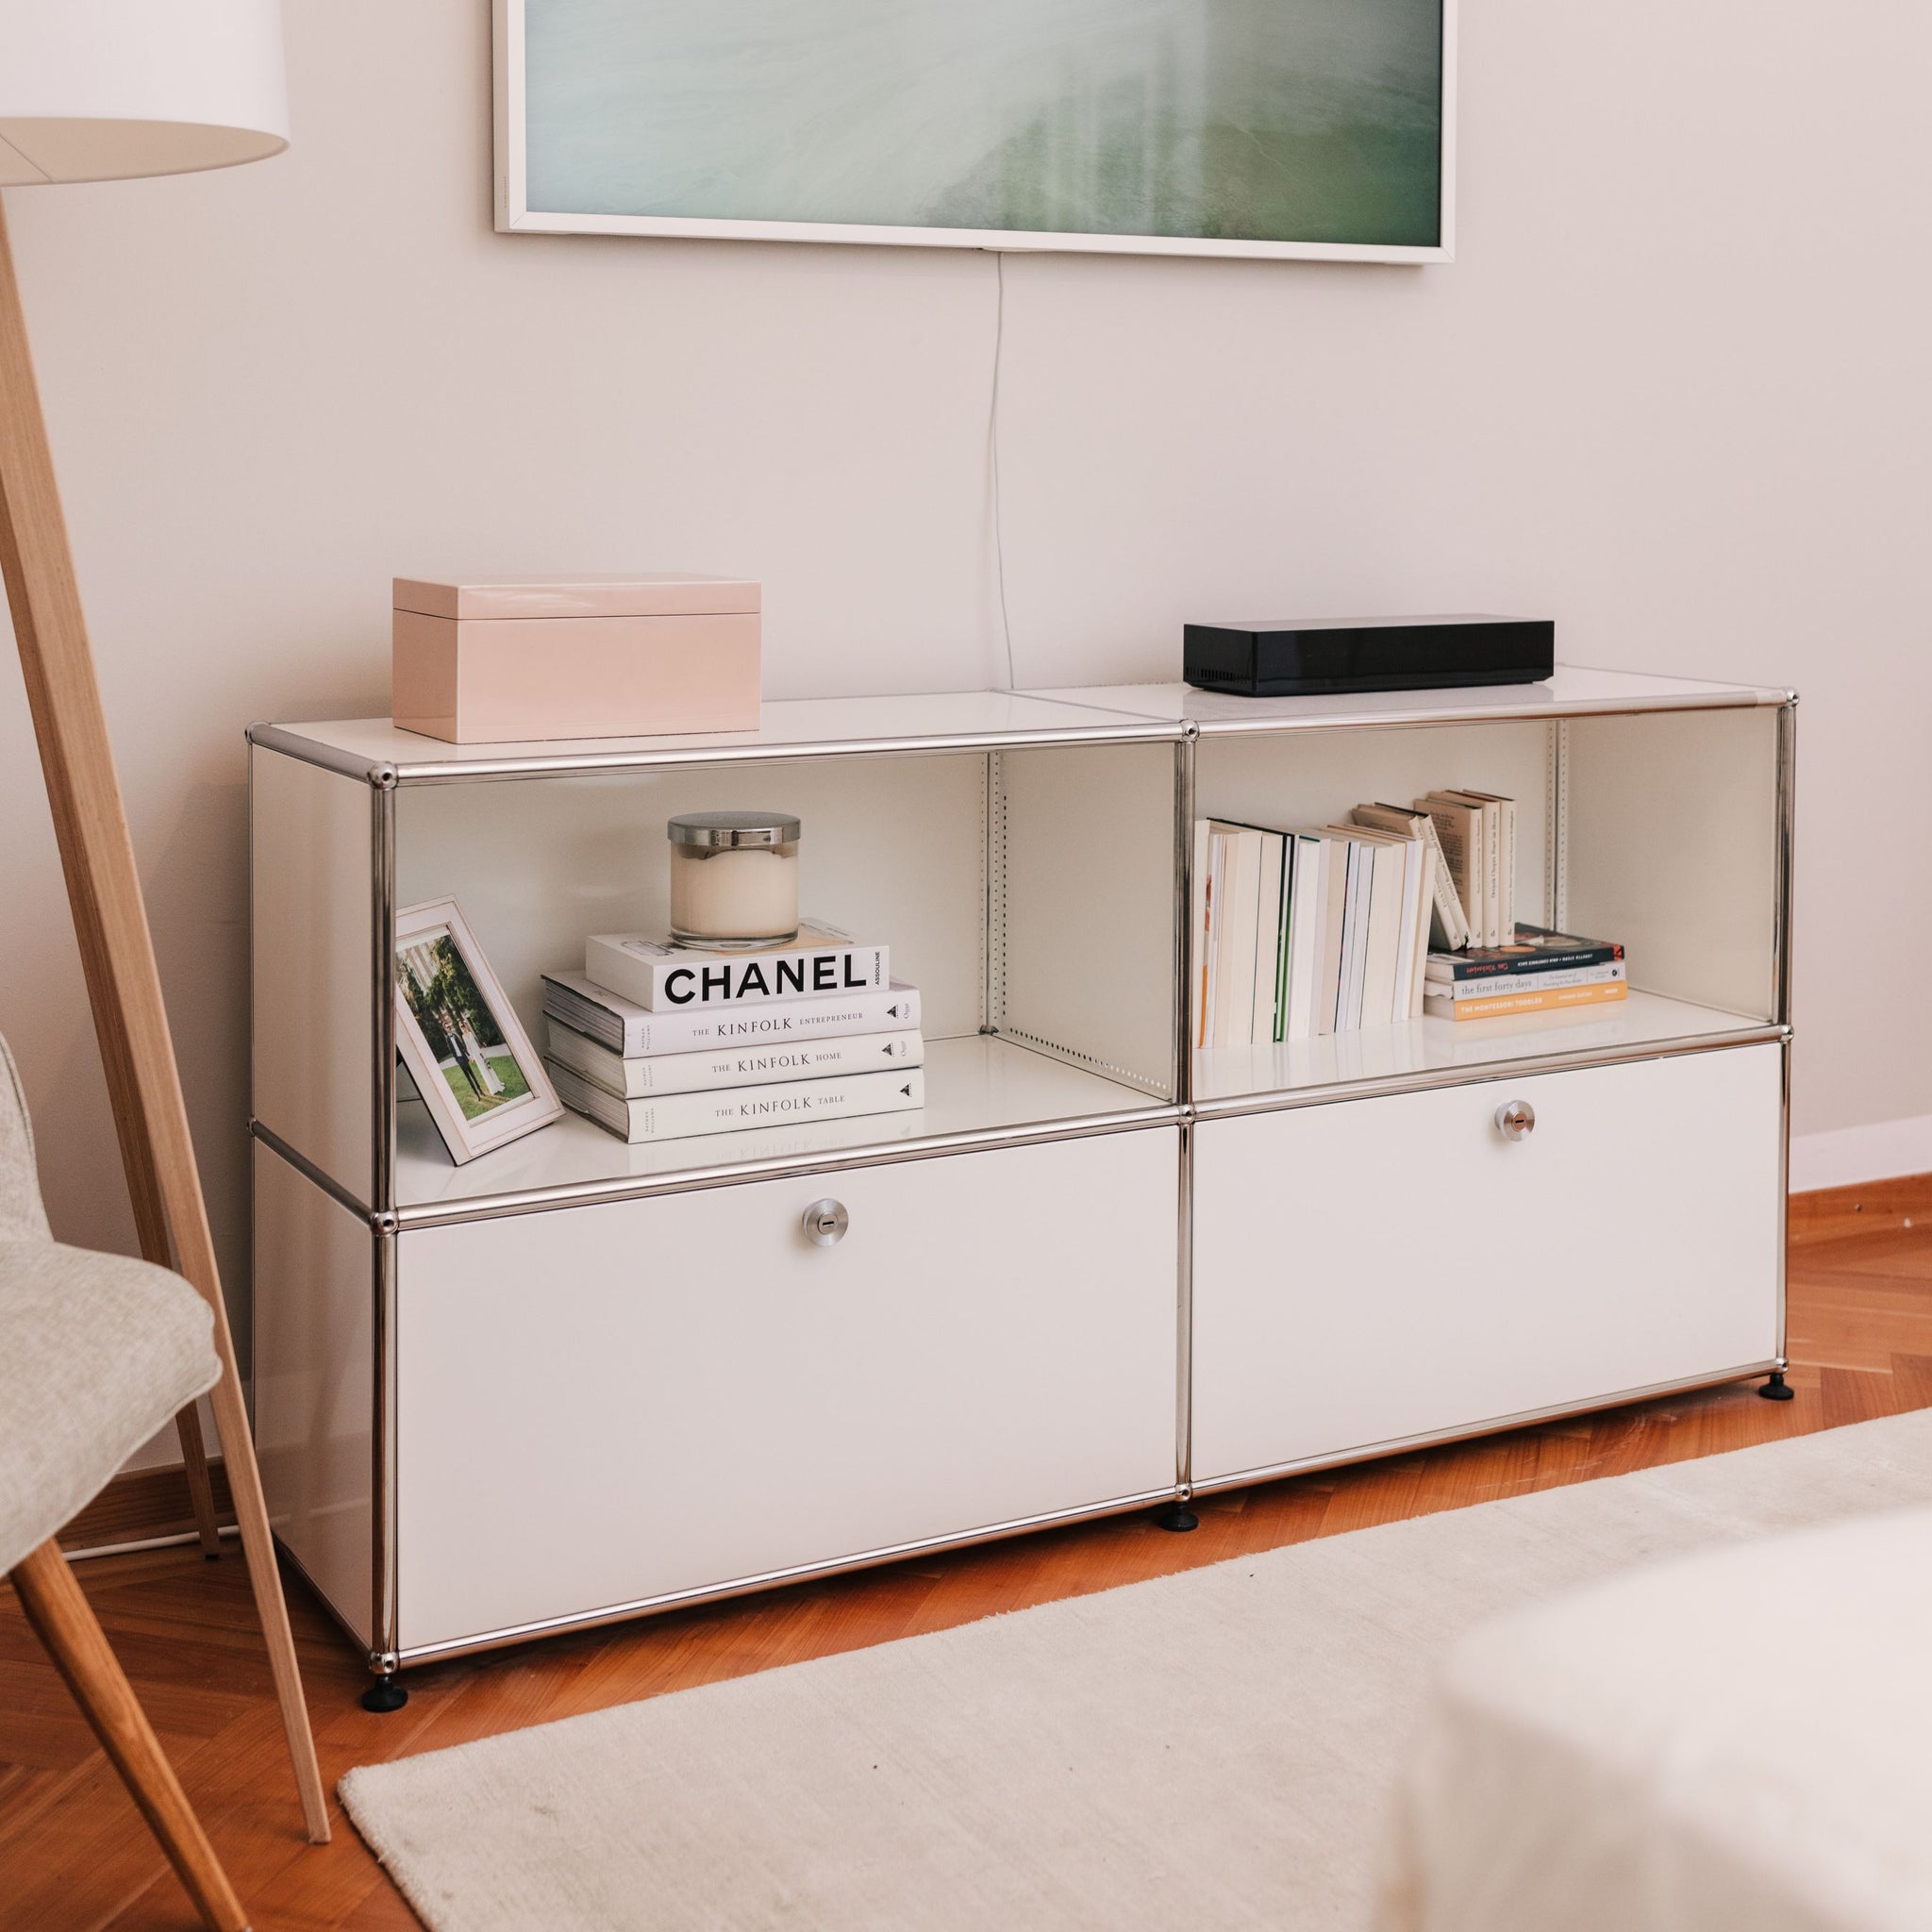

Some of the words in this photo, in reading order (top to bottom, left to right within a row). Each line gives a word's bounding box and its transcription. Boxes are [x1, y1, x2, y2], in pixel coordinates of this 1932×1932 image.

[665, 954, 867, 1005] CHANEL
[1462, 985, 1474, 995] the
[1476, 982, 1492, 993] first
[1494, 981, 1513, 994] forty
[1515, 979, 1532, 991] days
[1474, 1000, 1513, 1011] MONTESSORI
[1516, 997, 1542, 1007] TODDLER
[692, 1027, 710, 1036] THE
[717, 1017, 792, 1036] KINFOLK
[800, 1012, 863, 1025] ENTREPRENEUR
[712, 1063, 731, 1073] THE
[738, 1053, 810, 1073] KINFOLK
[816, 1052, 842, 1061] HOME
[715, 1108, 734, 1117] THE
[741, 1096, 812, 1116] KINFOLK
[818, 1094, 845, 1105] TABLE
